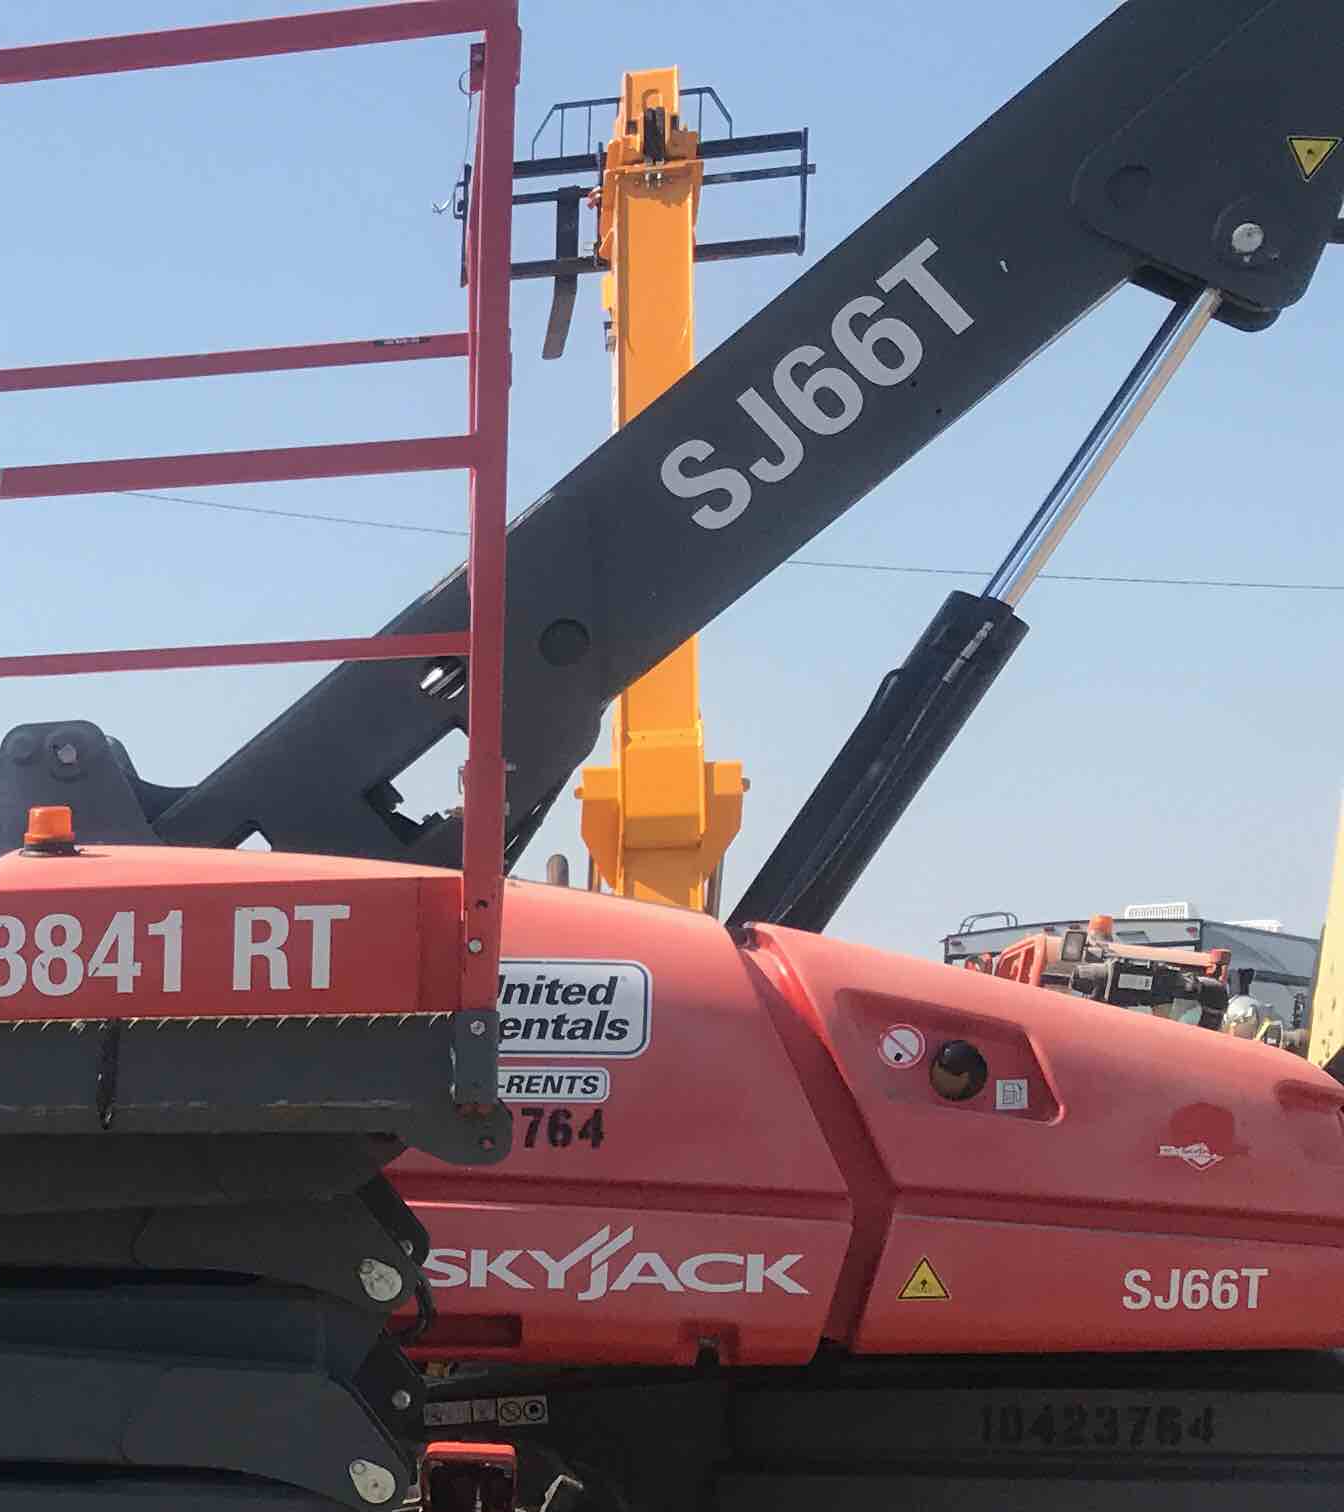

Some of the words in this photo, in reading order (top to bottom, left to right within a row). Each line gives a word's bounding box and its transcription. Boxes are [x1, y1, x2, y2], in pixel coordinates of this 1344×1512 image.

[661, 238, 975, 529] SJ66T
[232, 904, 350, 990] RT
[498, 974, 619, 1006] nited
[498, 1011, 630, 1042] entals
[498, 1074, 600, 1095] -RENTS
[520, 1107, 605, 1149] 764
[423, 1224, 811, 1301] SKYJACK
[1122, 1268, 1269, 1310] SJ66T
